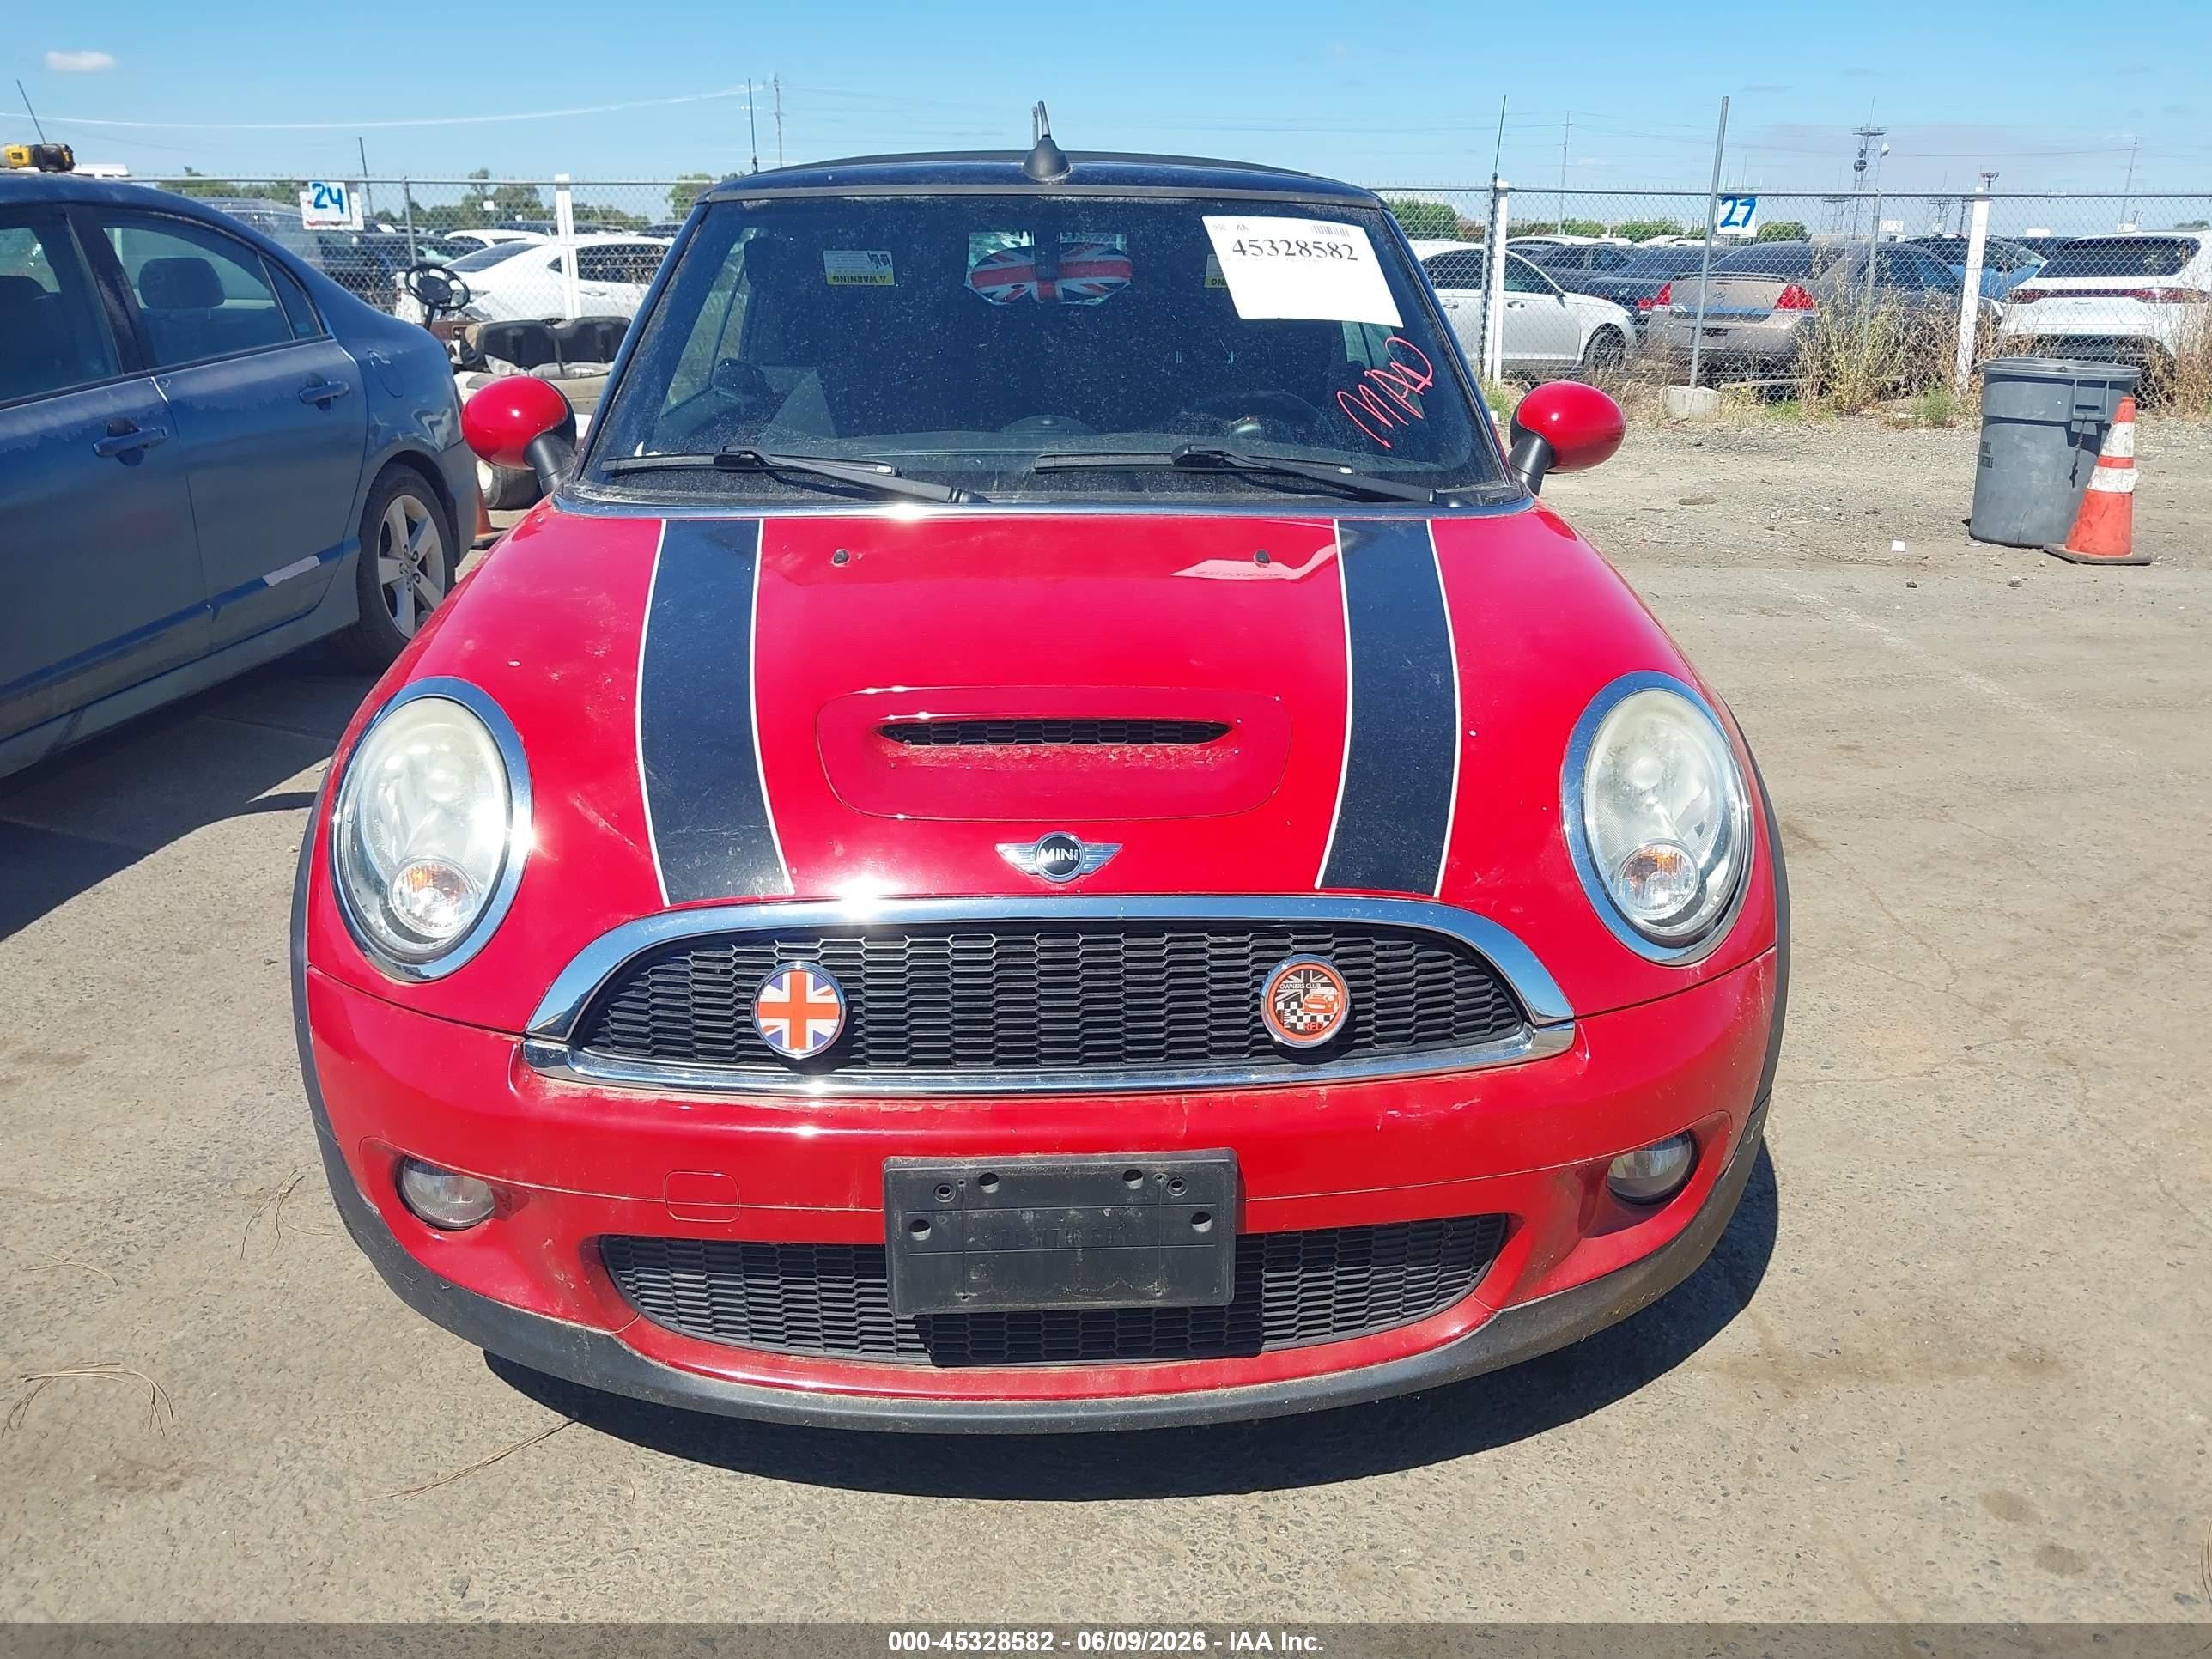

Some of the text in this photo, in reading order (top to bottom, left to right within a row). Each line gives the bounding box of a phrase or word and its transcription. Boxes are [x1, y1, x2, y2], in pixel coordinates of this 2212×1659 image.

[312, 183, 344, 214] 24
[1720, 195, 1757, 228] 27
[1232, 239, 1358, 261] 45328582
[833, 275, 878, 283] WARNING
[1039, 848, 1079, 861] MINI
[1304, 1022, 1323, 1031] RED
